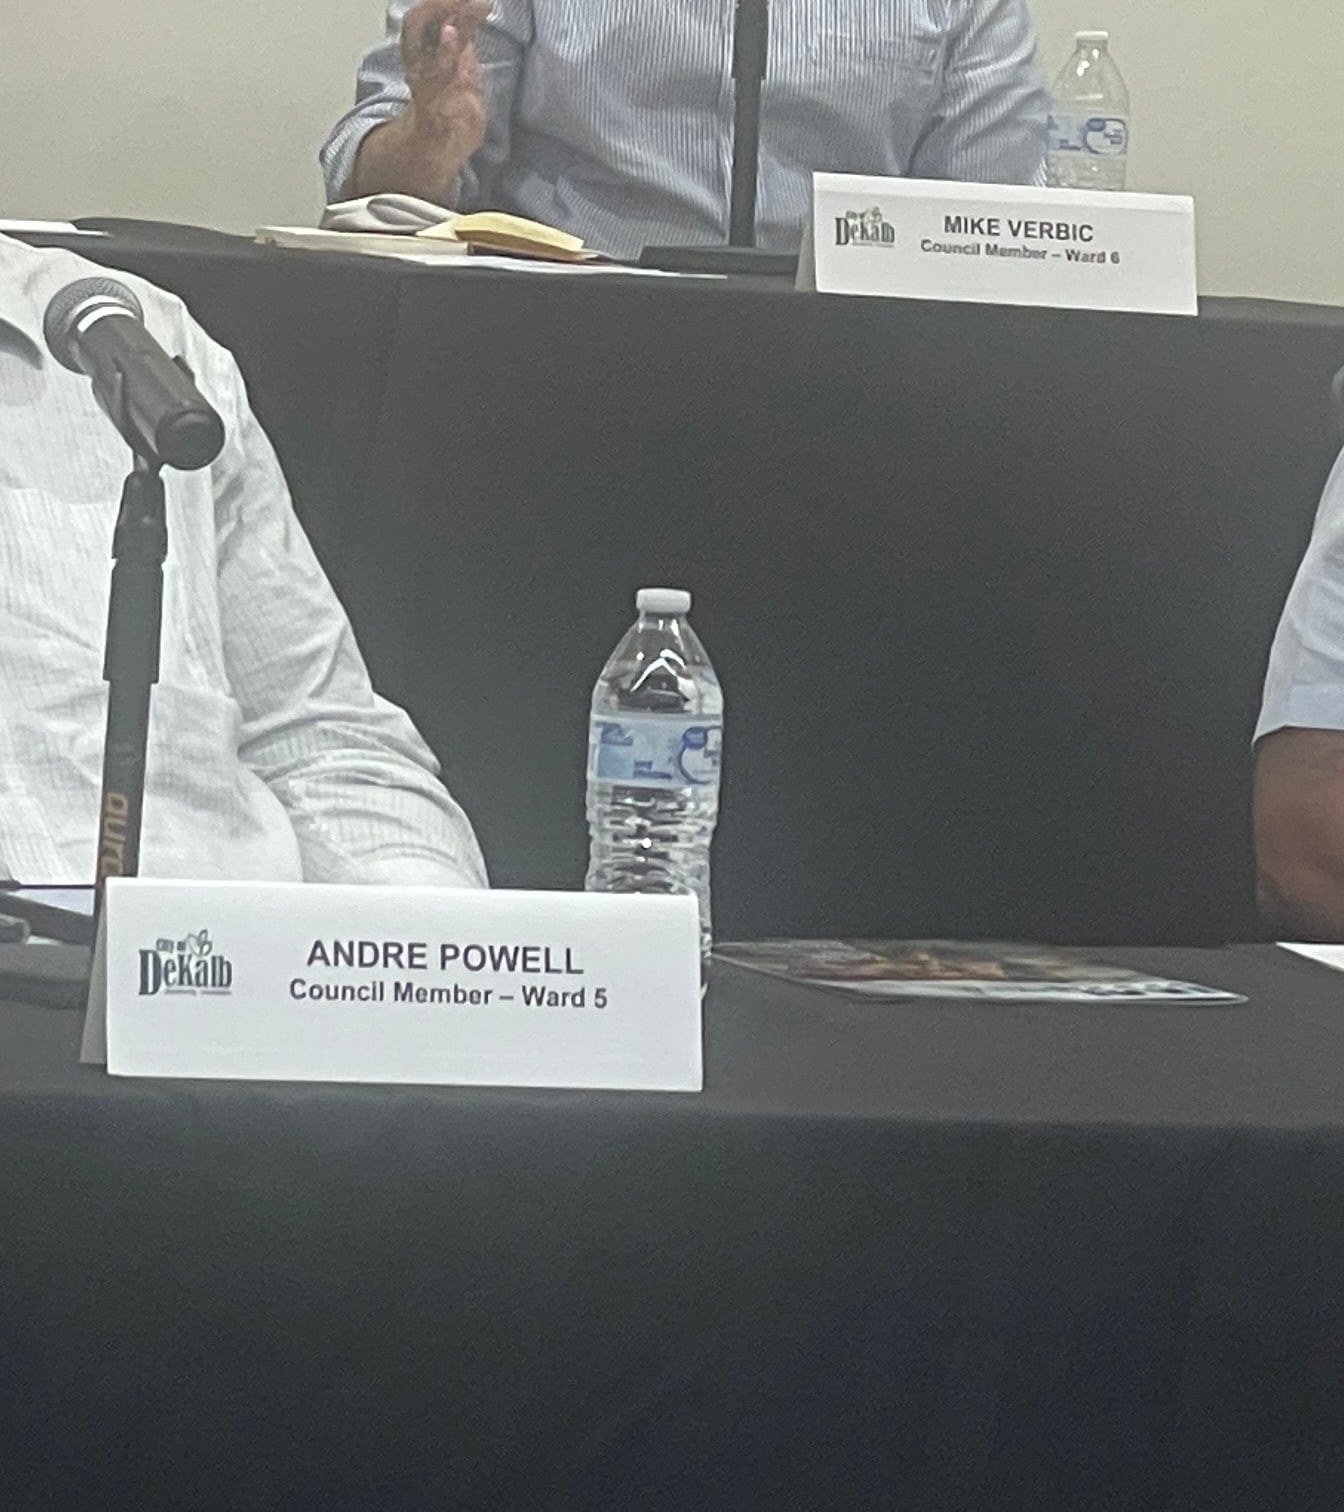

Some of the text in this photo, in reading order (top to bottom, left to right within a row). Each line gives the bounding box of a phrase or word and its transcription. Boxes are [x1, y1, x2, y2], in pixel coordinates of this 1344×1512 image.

[944, 215, 1094, 243] MIKE VERBIC
[920, 238, 981, 256] Council
[985, 242, 1048, 260] Member
[1064, 248, 1106, 264] Ward
[1110, 251, 1121, 265] 6
[138, 949, 233, 995] DeKalb
[306, 939, 584, 975] ANDRE POWELL
[289, 978, 385, 1002] Council
[393, 980, 494, 1005] Member
[521, 985, 586, 1008] Ward
[594, 987, 608, 1009] 5
